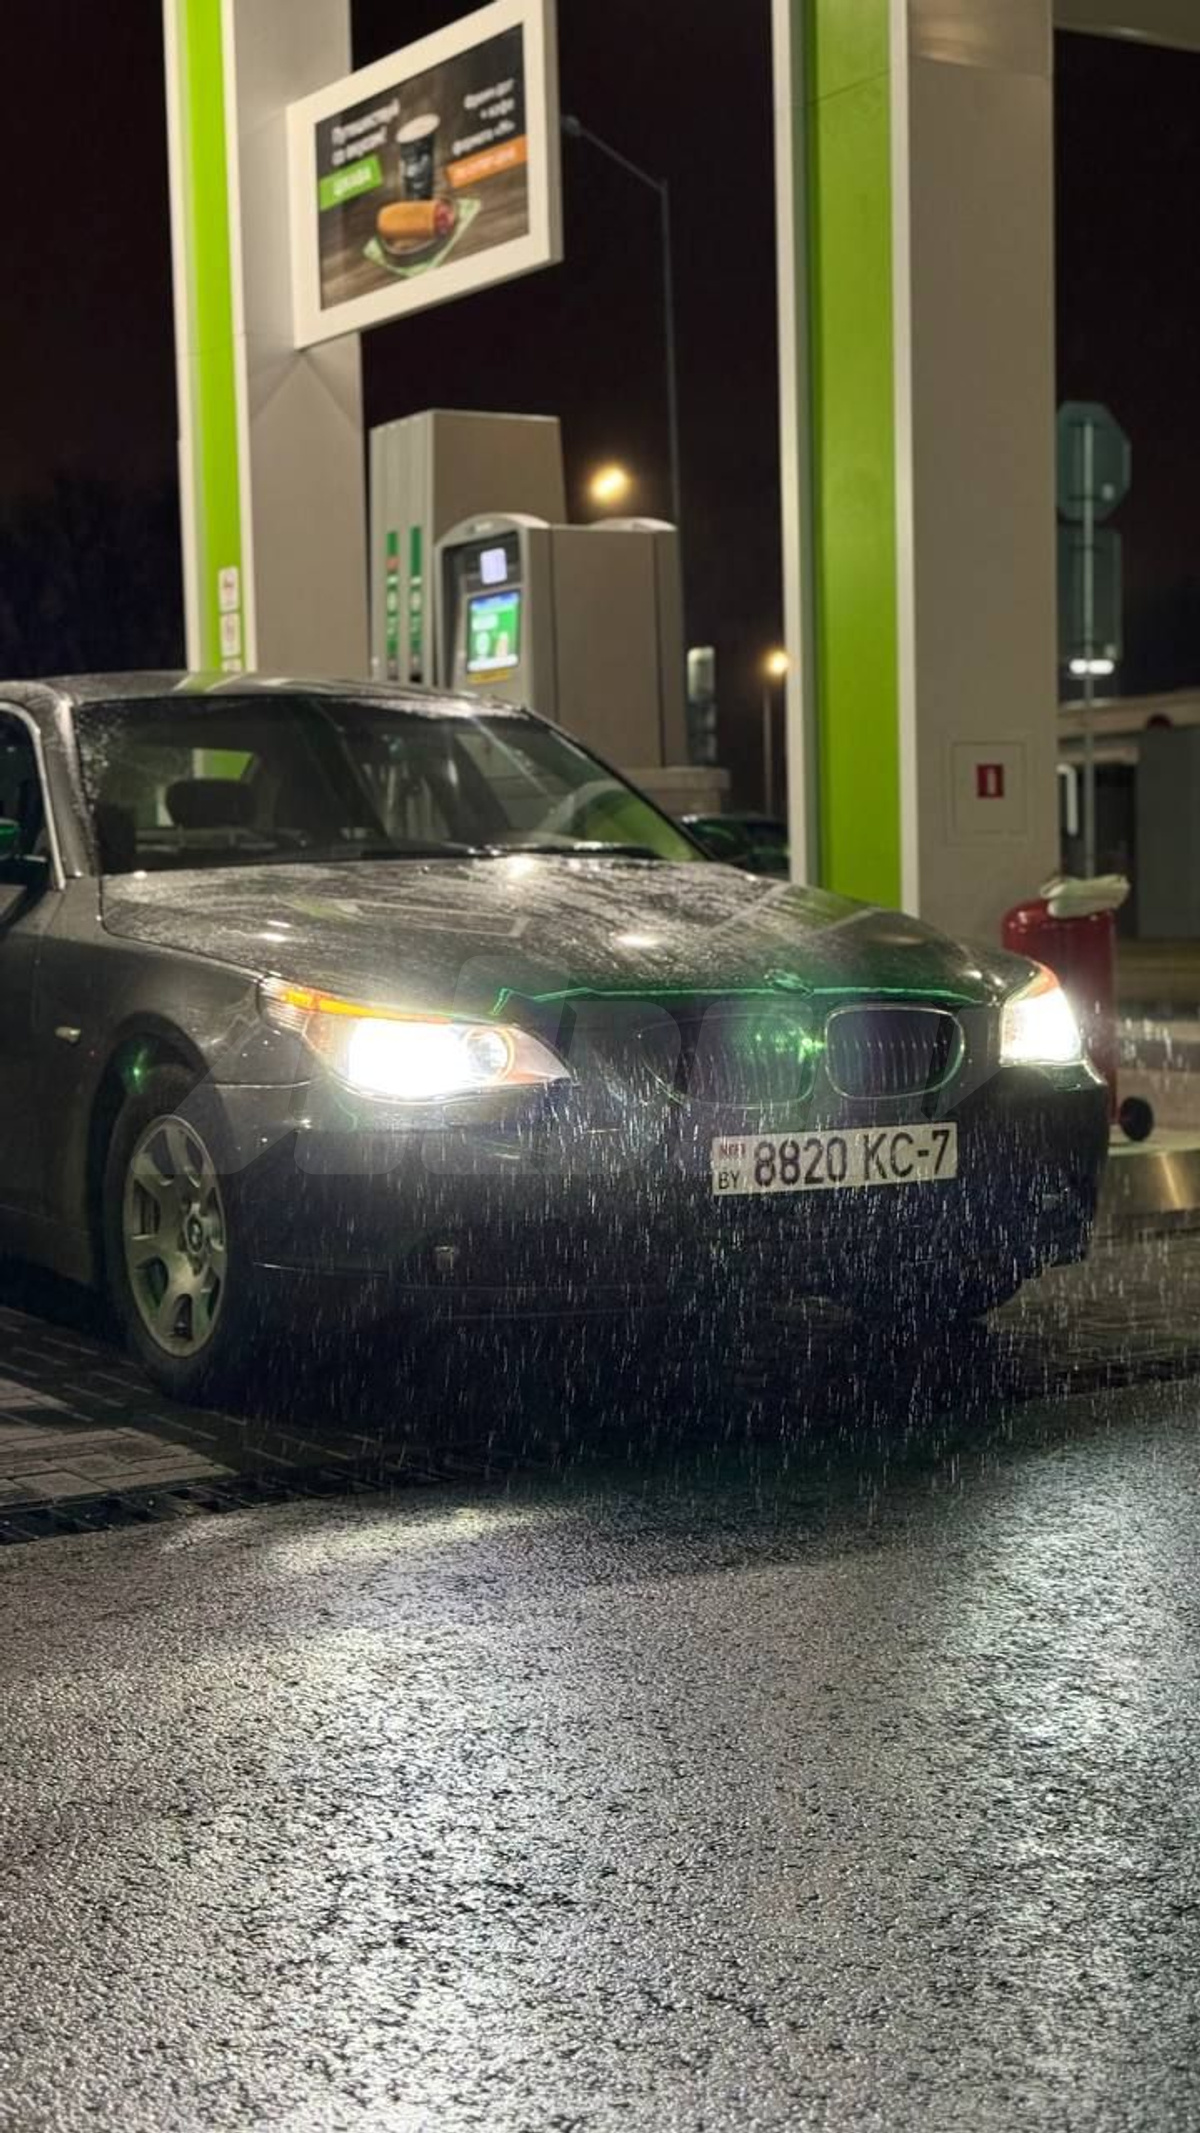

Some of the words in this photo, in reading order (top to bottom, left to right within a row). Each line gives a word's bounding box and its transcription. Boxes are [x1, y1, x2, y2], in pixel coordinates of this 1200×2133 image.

[754, 1137, 848, 1187] 8820
[863, 1129, 950, 1180] KC-7
[718, 1170, 740, 1190] BY
